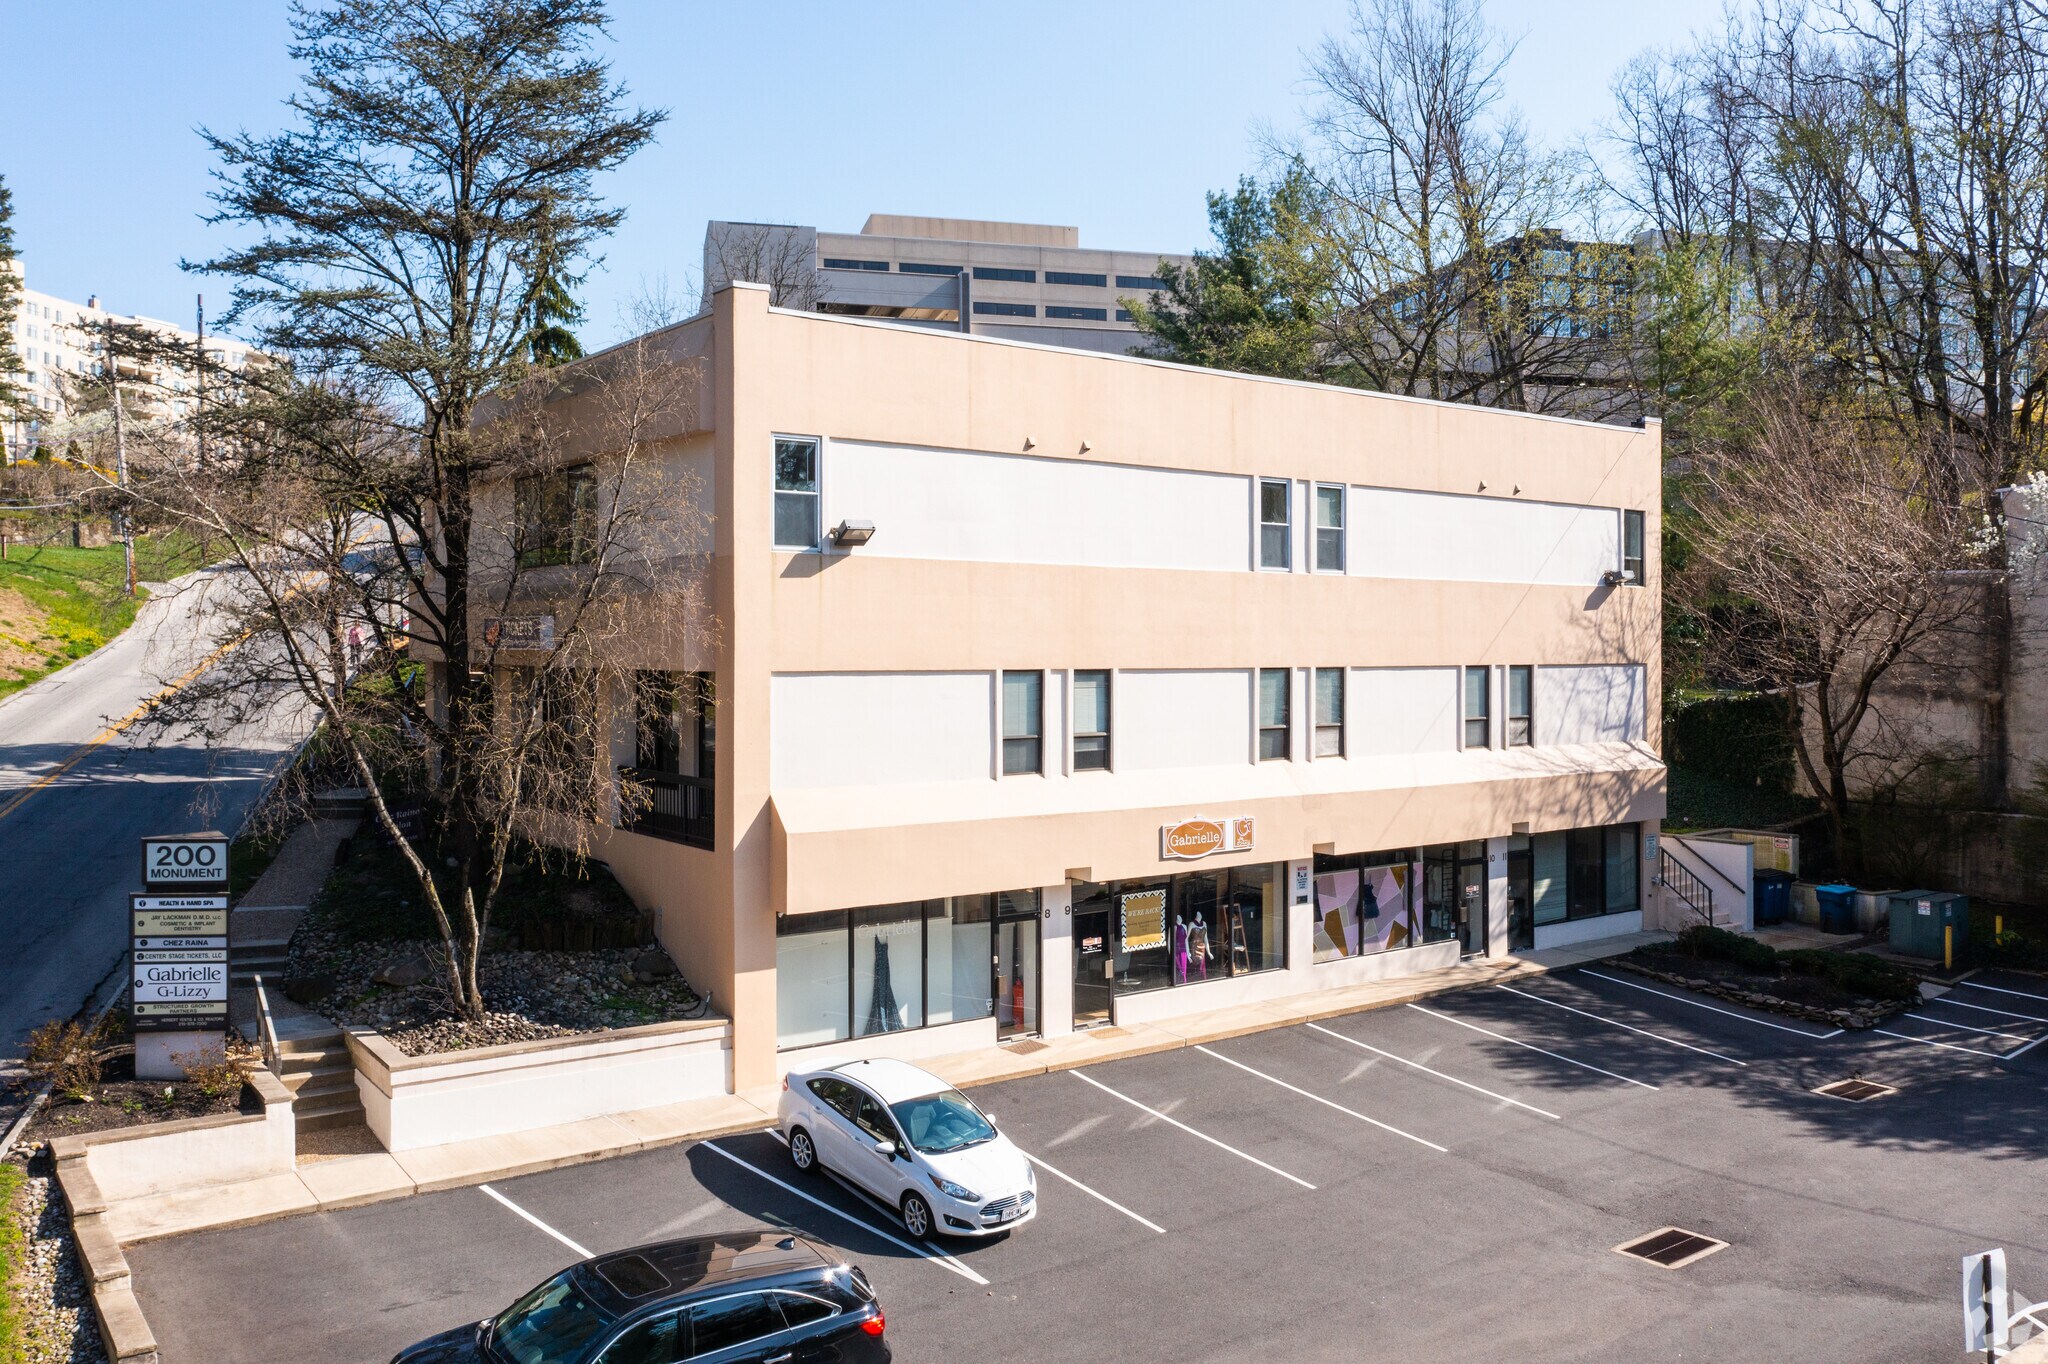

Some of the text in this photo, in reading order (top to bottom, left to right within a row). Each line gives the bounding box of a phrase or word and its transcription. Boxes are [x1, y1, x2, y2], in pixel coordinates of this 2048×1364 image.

[1170, 831, 1220, 847] Gabrielle
[156, 845, 216, 867] 200
[150, 868, 223, 878] MONUMENT
[1045, 908, 1051, 918] 8
[1064, 905, 1071, 915] 9
[147, 966, 221, 982] Gabrielle
[157, 985, 211, 999] G-Lizzy
